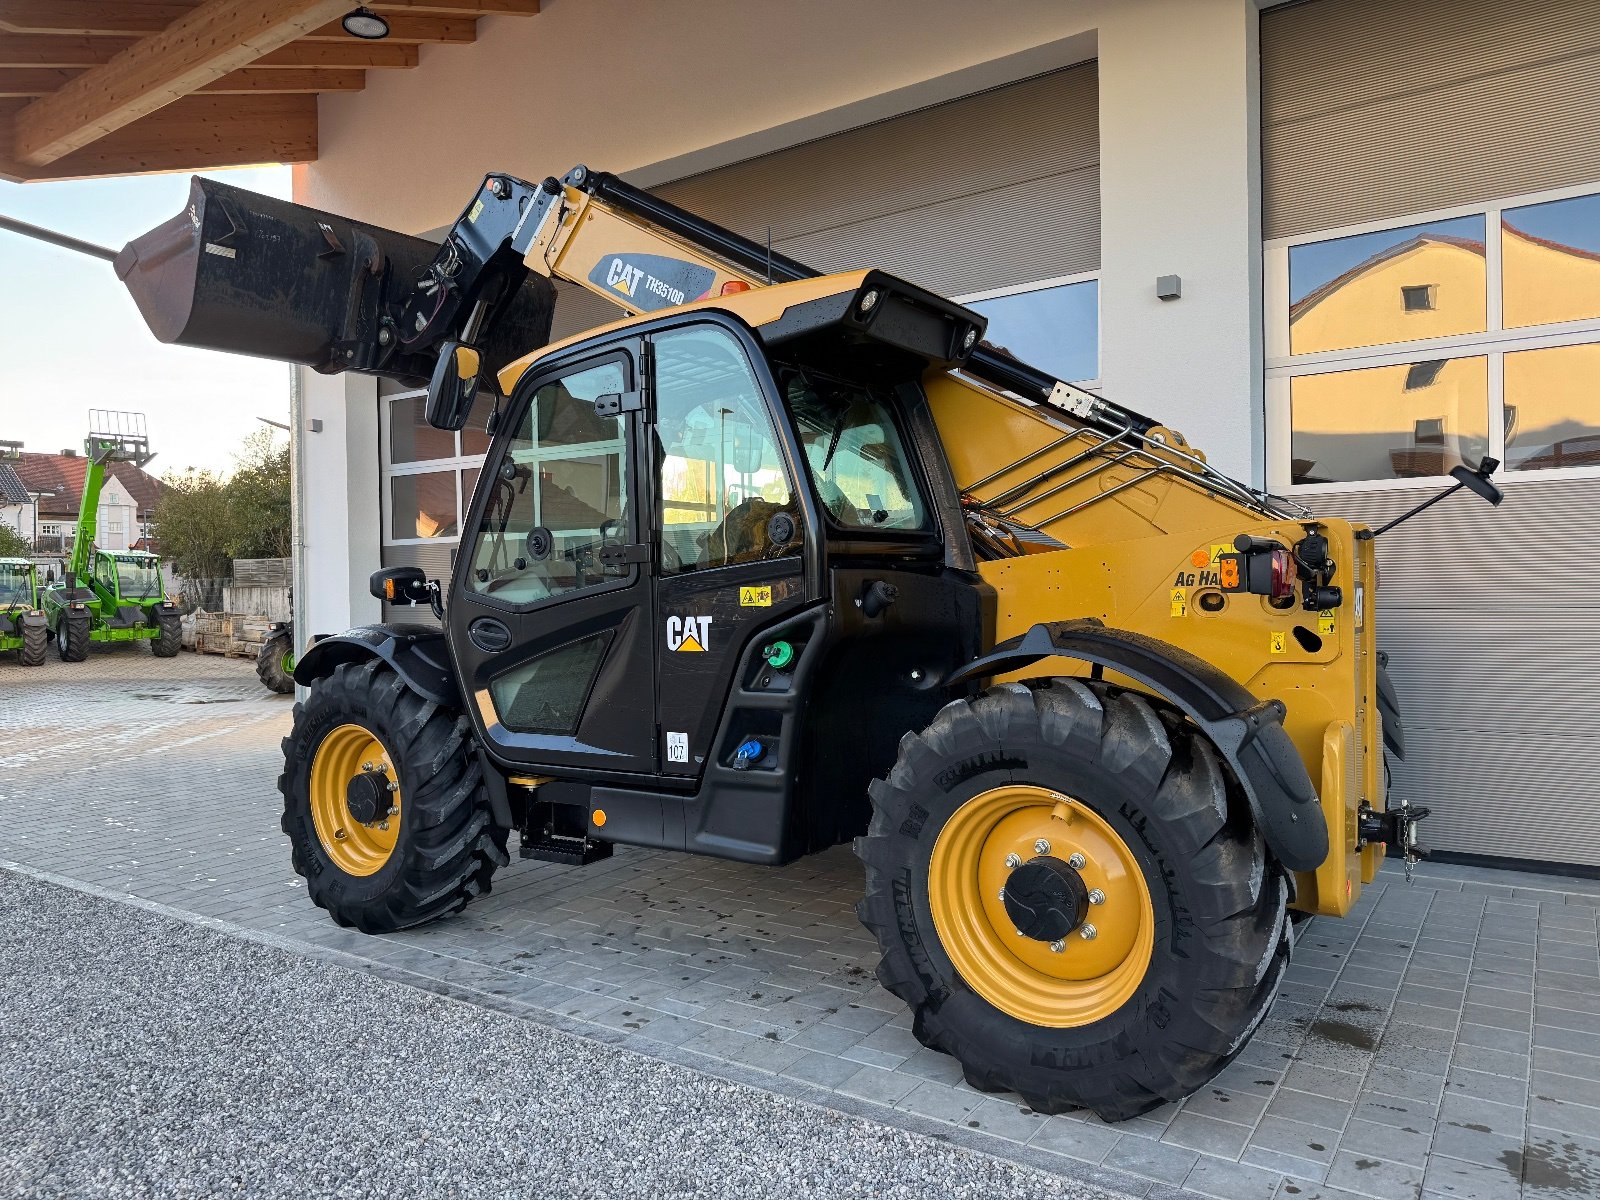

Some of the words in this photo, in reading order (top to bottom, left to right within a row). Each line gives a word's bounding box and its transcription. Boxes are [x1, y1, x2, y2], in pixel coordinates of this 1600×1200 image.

[606, 257, 645, 298] CAT
[645, 274, 685, 306] TH3510D
[1198, 570, 1222, 586] HA
[666, 615, 713, 652] CAT
[669, 745, 684, 760] 107
